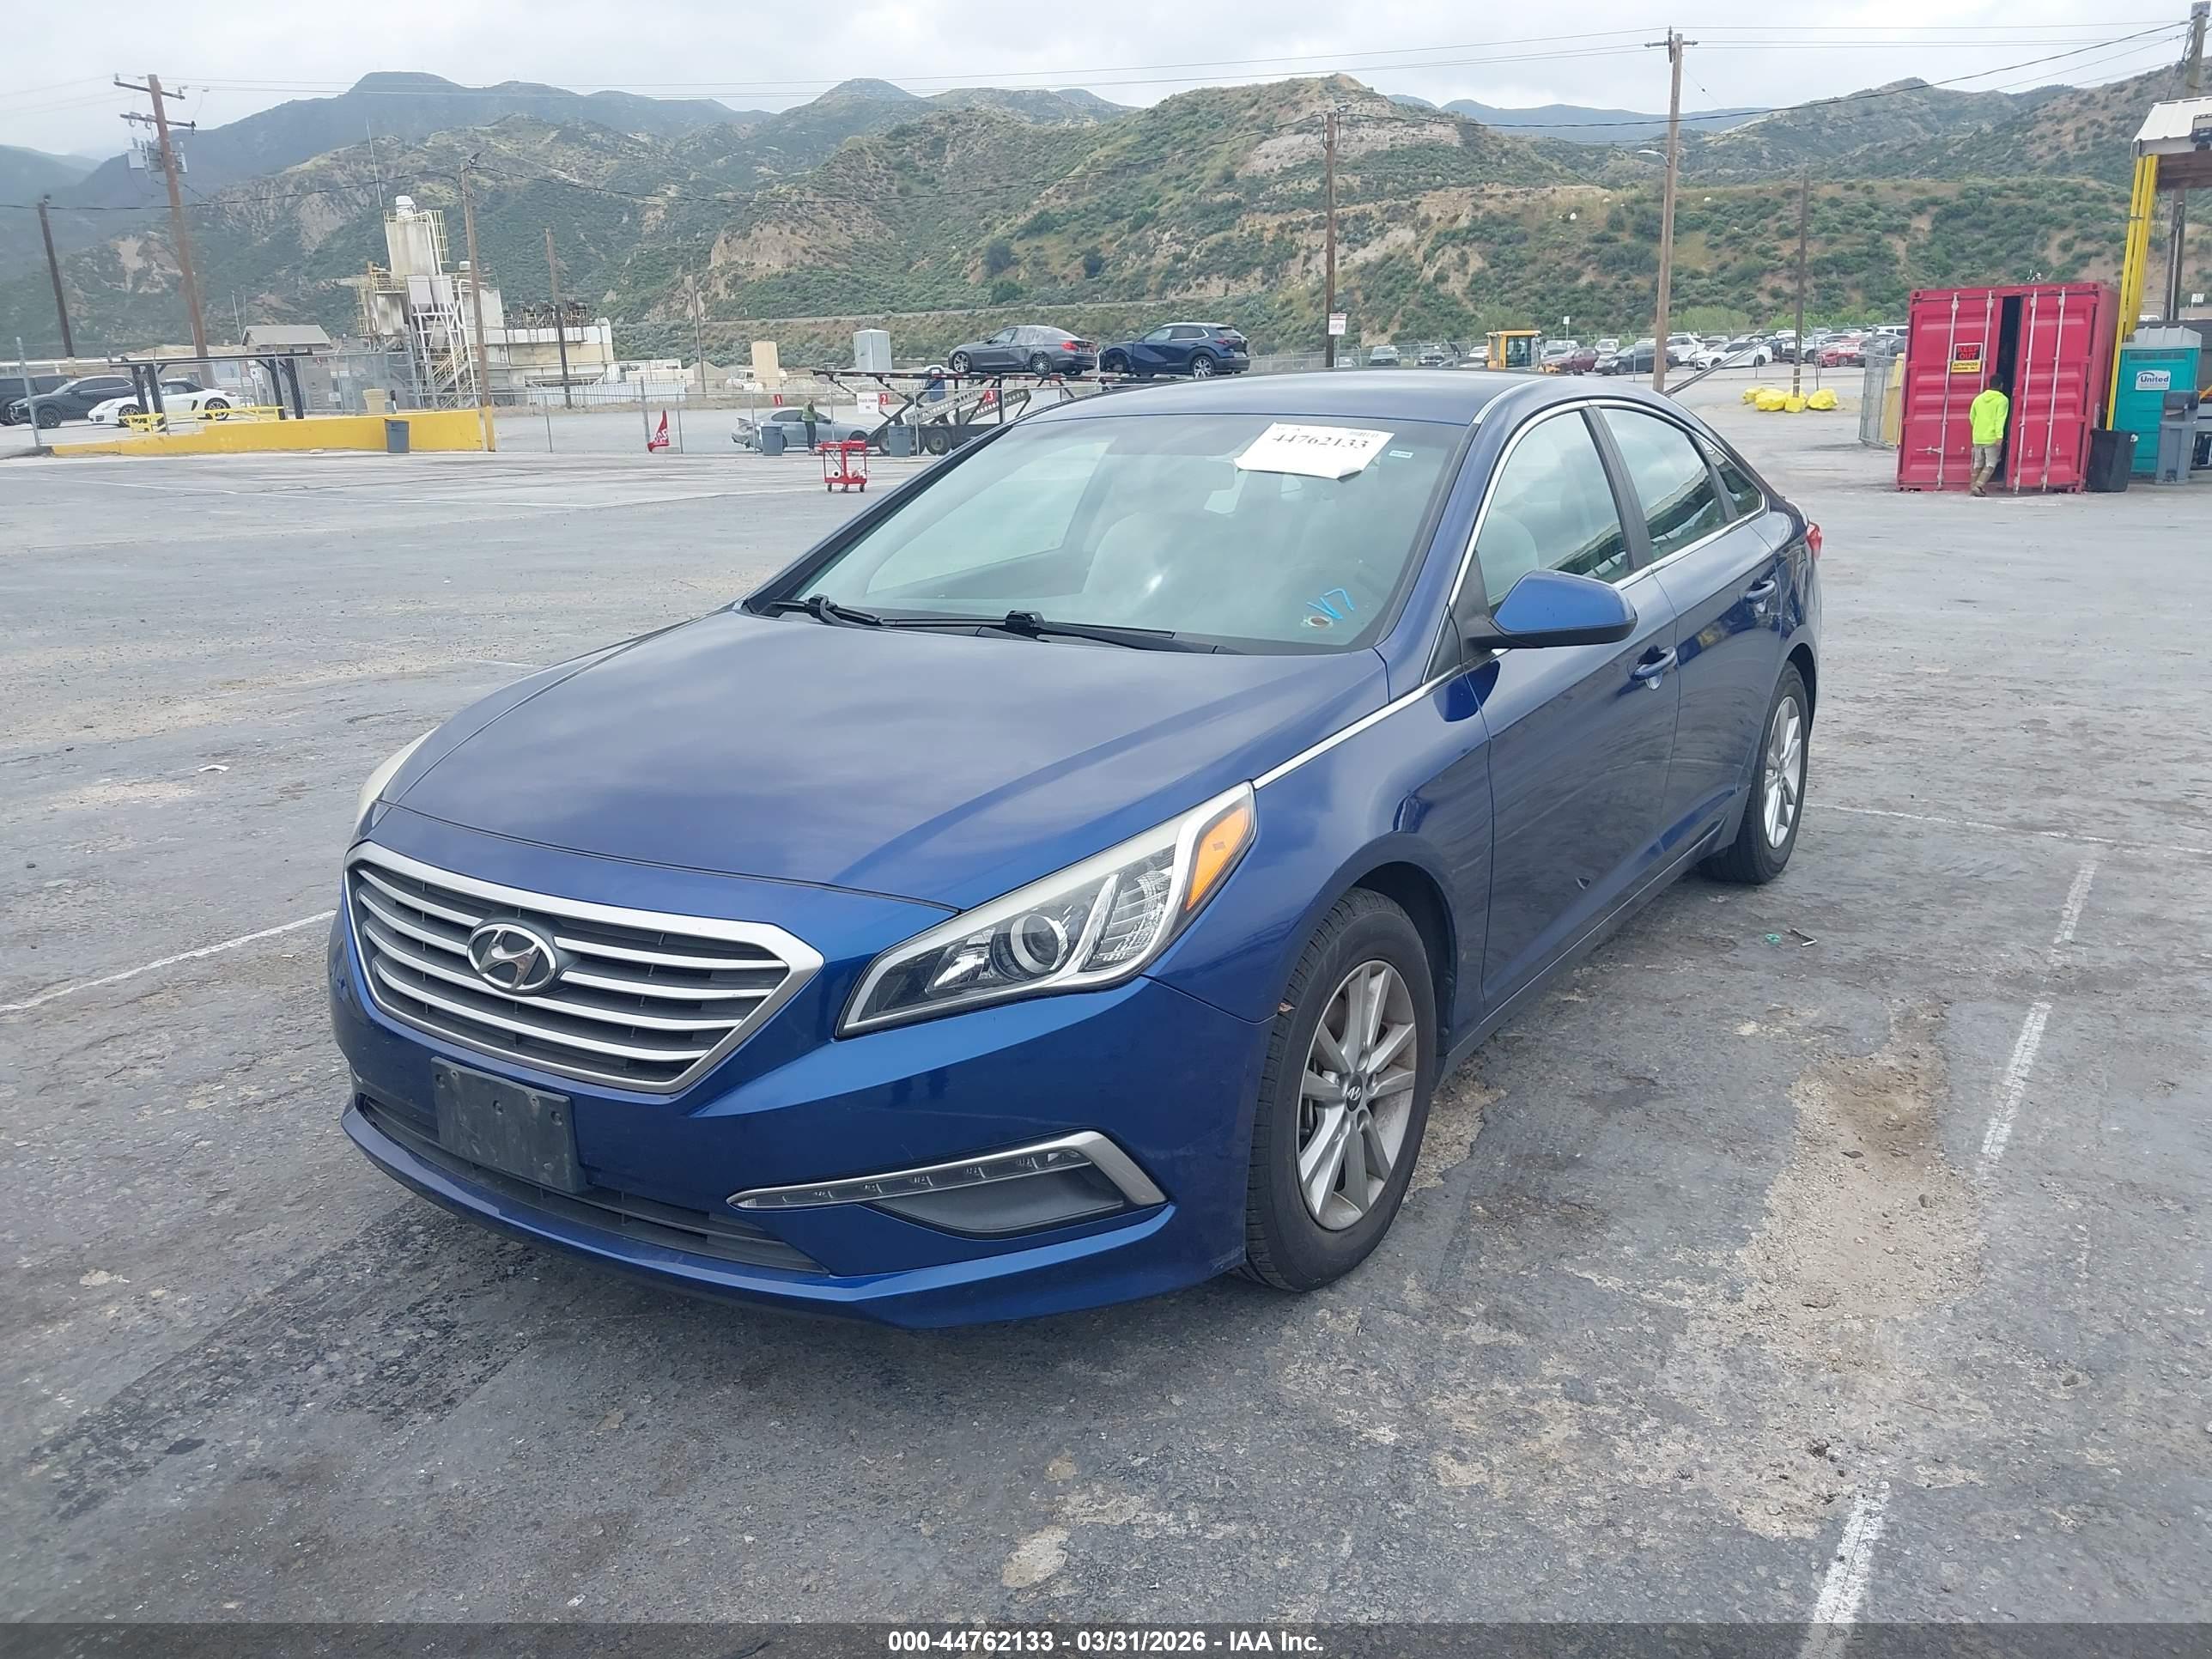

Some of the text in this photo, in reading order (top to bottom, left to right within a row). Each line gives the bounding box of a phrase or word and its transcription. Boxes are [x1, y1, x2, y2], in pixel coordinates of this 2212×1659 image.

[880, 394, 887, 404] 2
[988, 391, 994, 401] 3
[1273, 434, 1370, 448] 44762133
